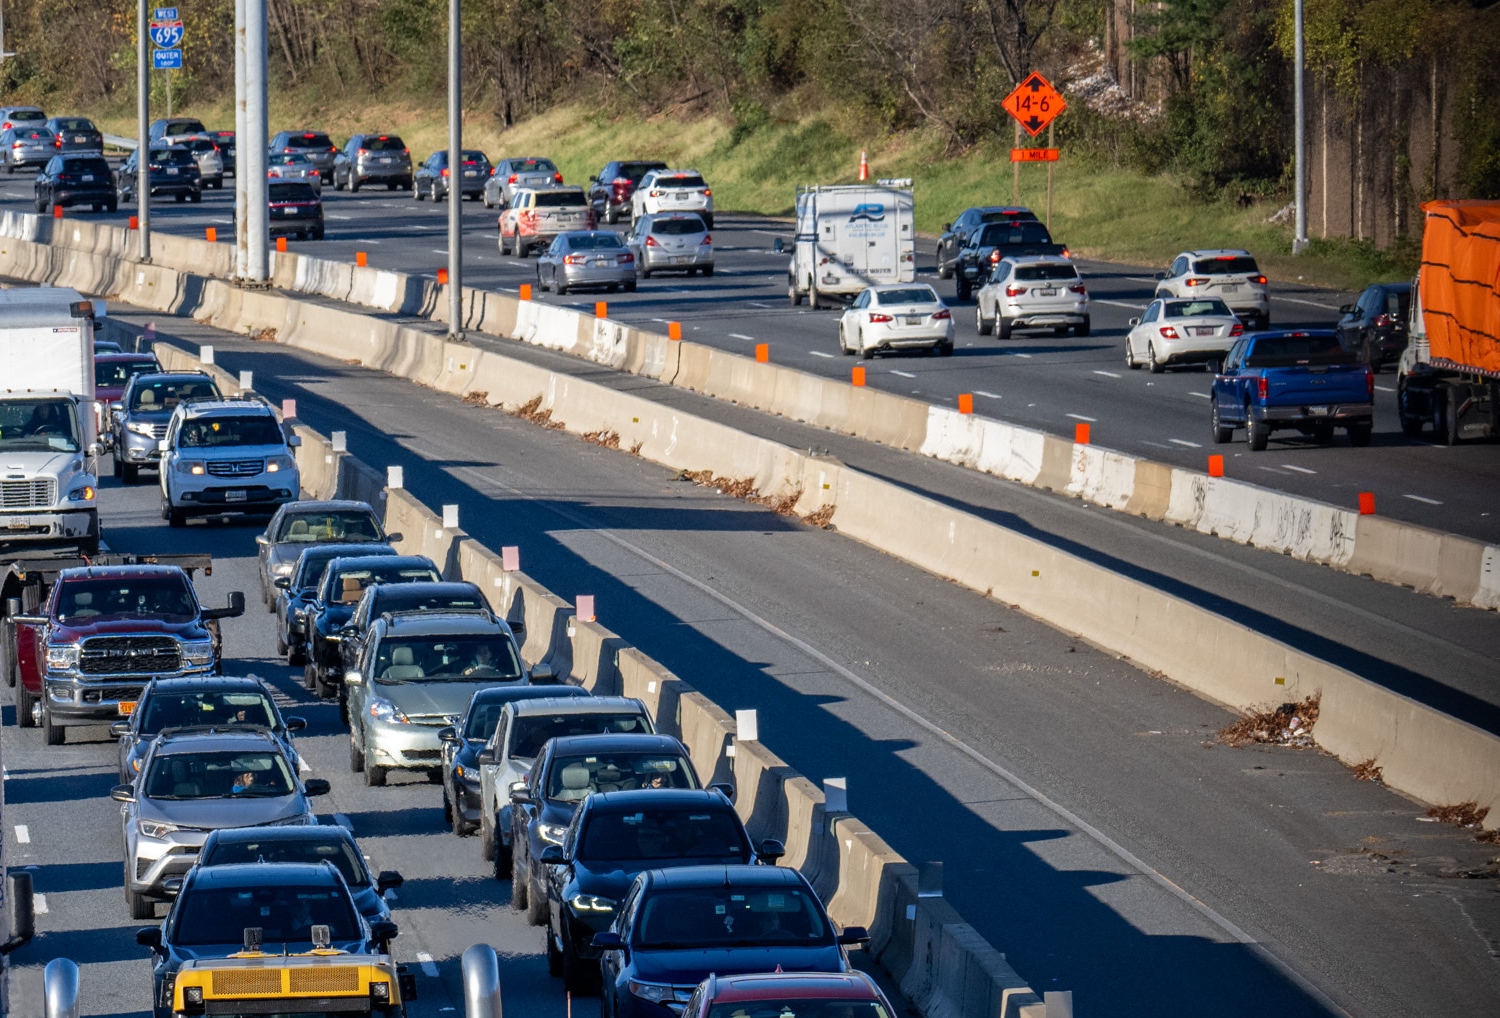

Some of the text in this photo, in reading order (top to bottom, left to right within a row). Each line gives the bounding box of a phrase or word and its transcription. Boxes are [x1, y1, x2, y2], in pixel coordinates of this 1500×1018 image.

[156, 27, 179, 43] 695
[156, 52, 179, 60] OUTER
[1030, 151, 1049, 159] MILE
